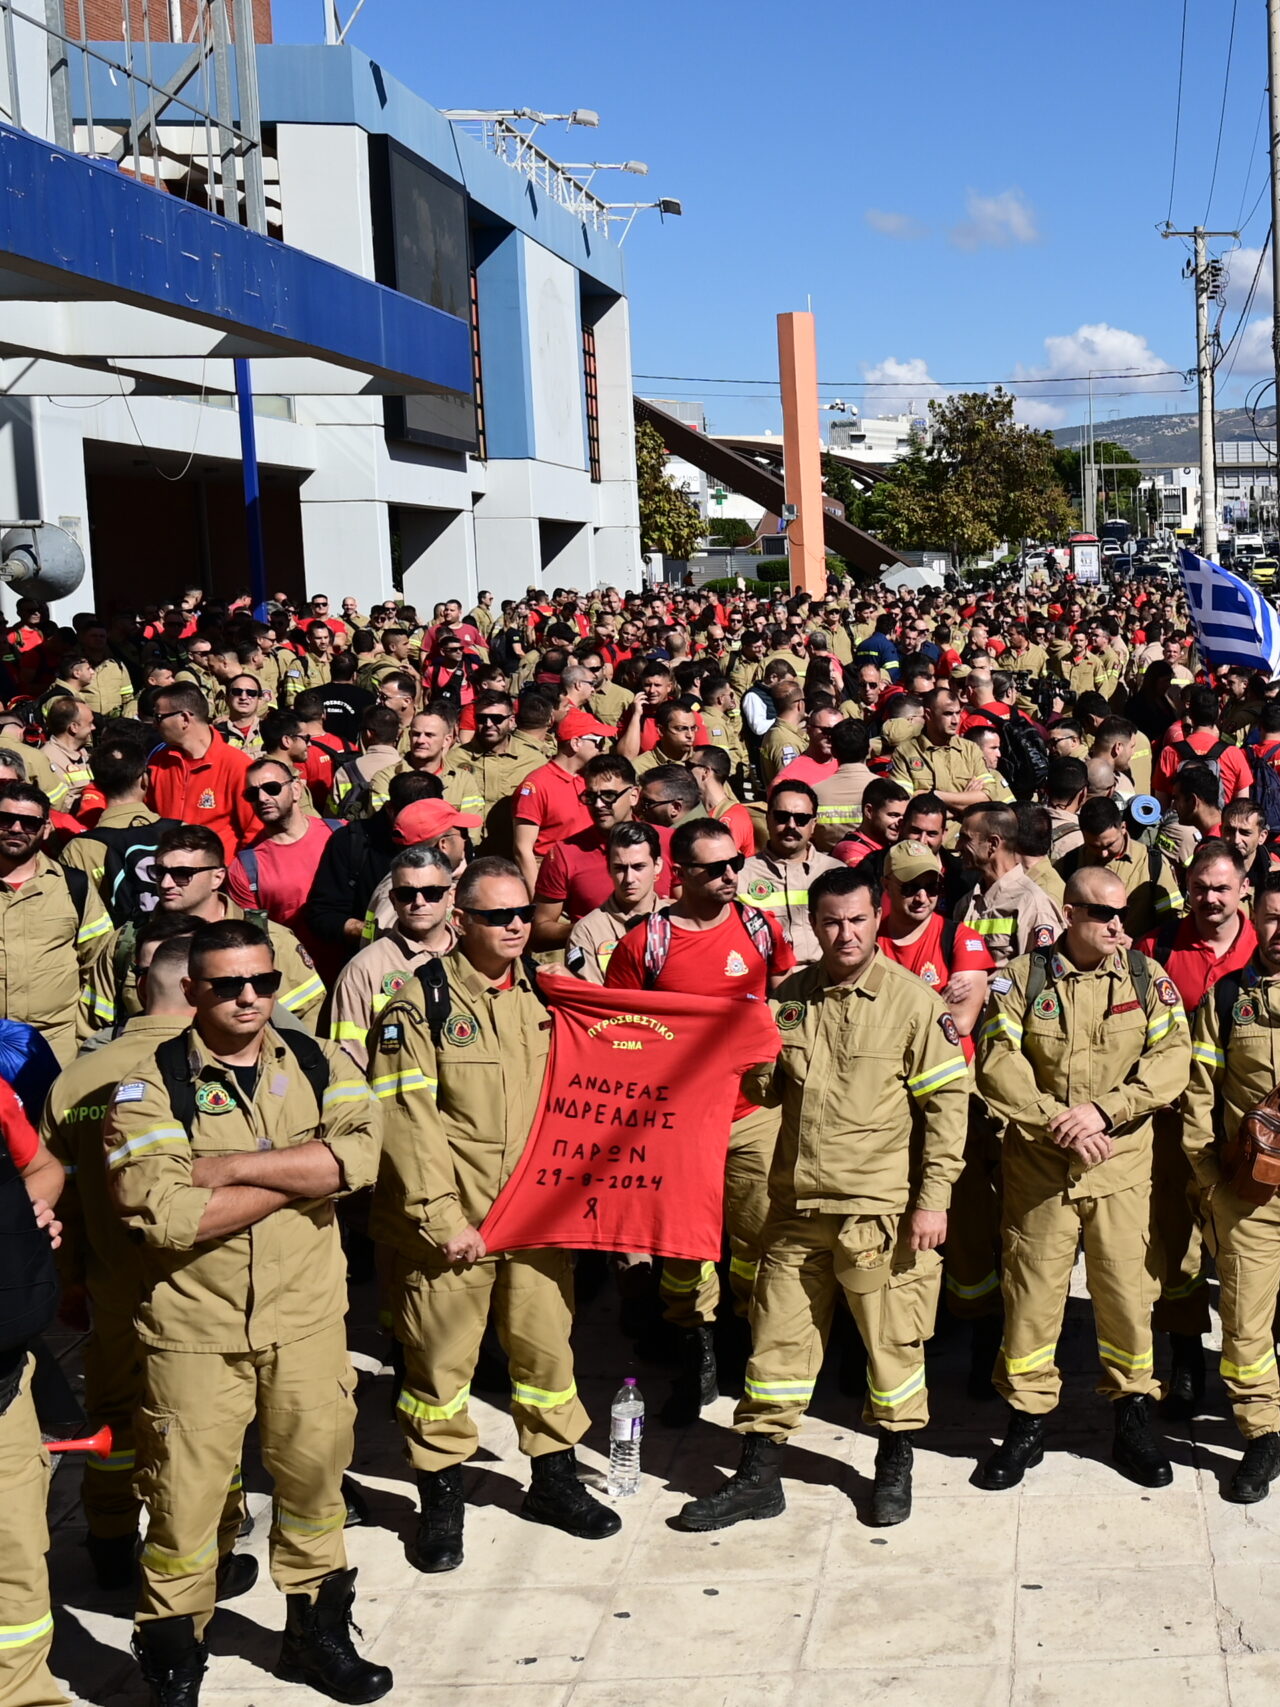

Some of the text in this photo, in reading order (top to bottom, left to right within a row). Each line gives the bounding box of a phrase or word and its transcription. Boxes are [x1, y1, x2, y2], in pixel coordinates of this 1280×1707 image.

[587, 1014, 675, 1040] ΠΥΡΟΣΒΕΣΤΙΚΟ
[612, 1040, 643, 1050] ΣΩΜΑ
[568, 1073, 670, 1101] ΑΝΔΡΕΑΣ
[552, 1139, 646, 1164] ΠΑΡΩΝ
